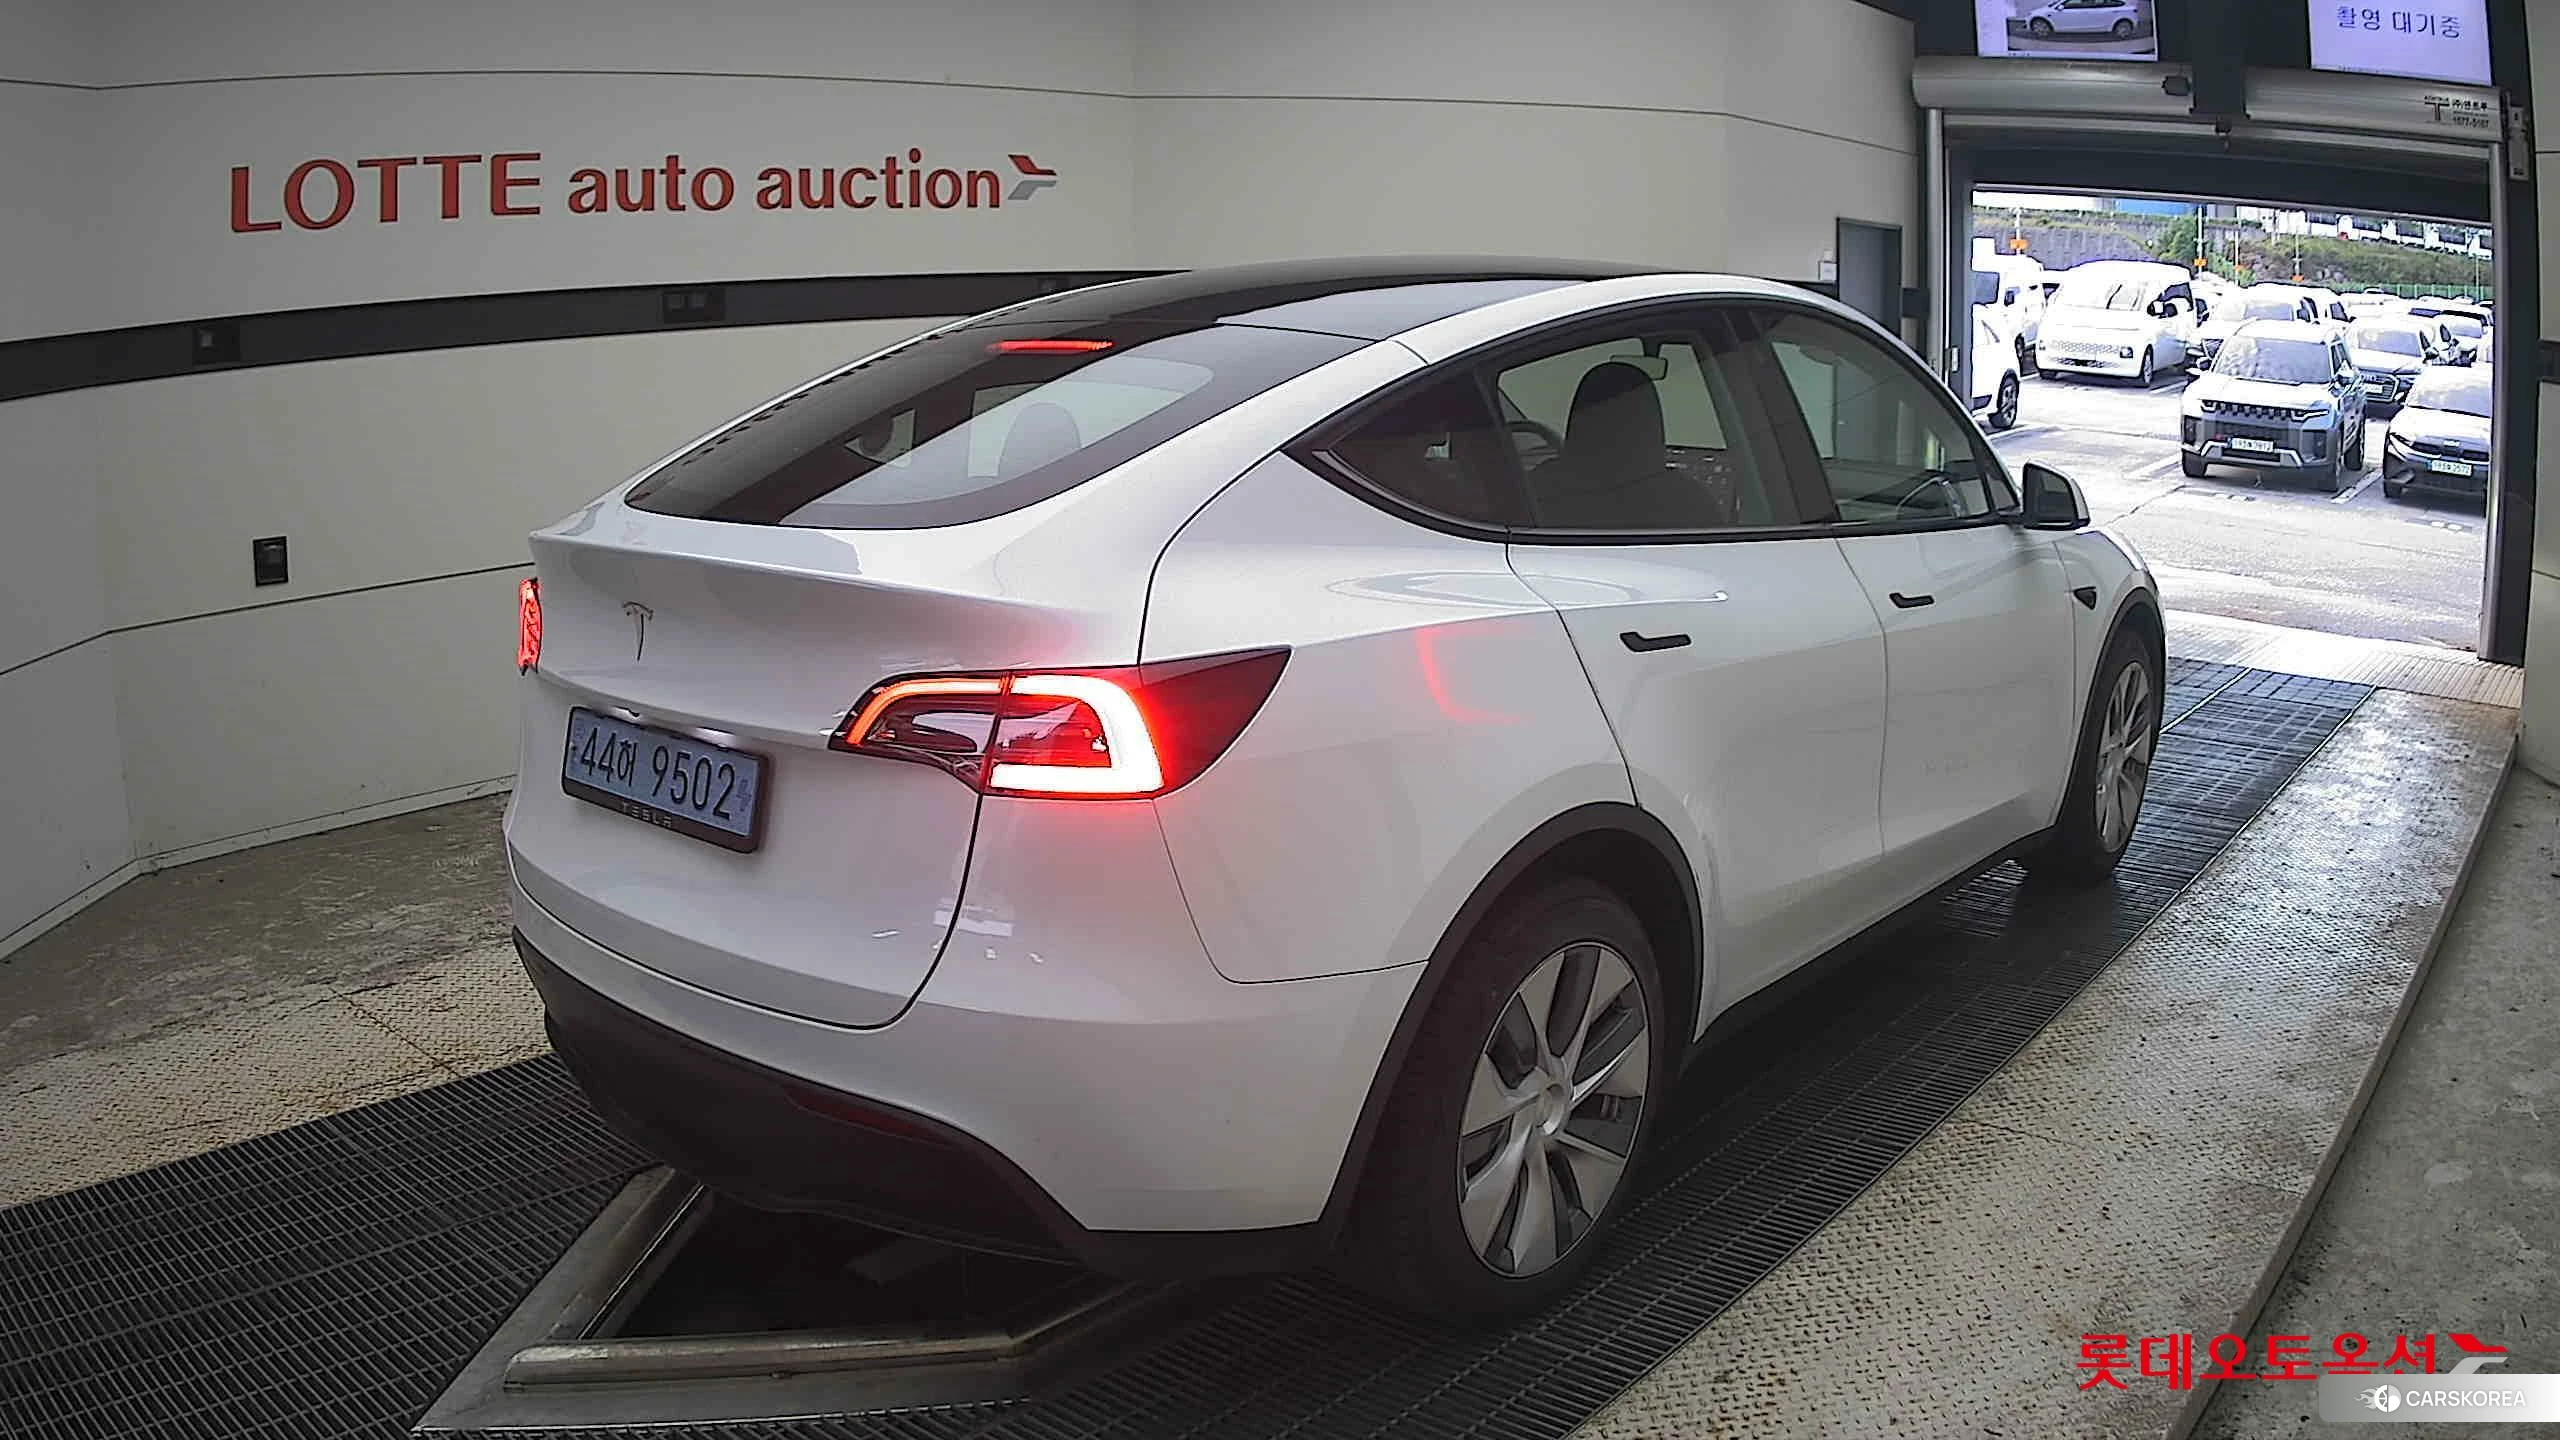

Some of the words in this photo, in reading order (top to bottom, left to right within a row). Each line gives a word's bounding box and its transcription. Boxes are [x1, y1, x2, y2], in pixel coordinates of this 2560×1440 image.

[2392, 11, 2460, 39] 대기중
[231, 152, 541, 233] LOTTE
[568, 155, 735, 214] auto
[756, 147, 1000, 210] auction
[652, 745, 736, 821] 9502
